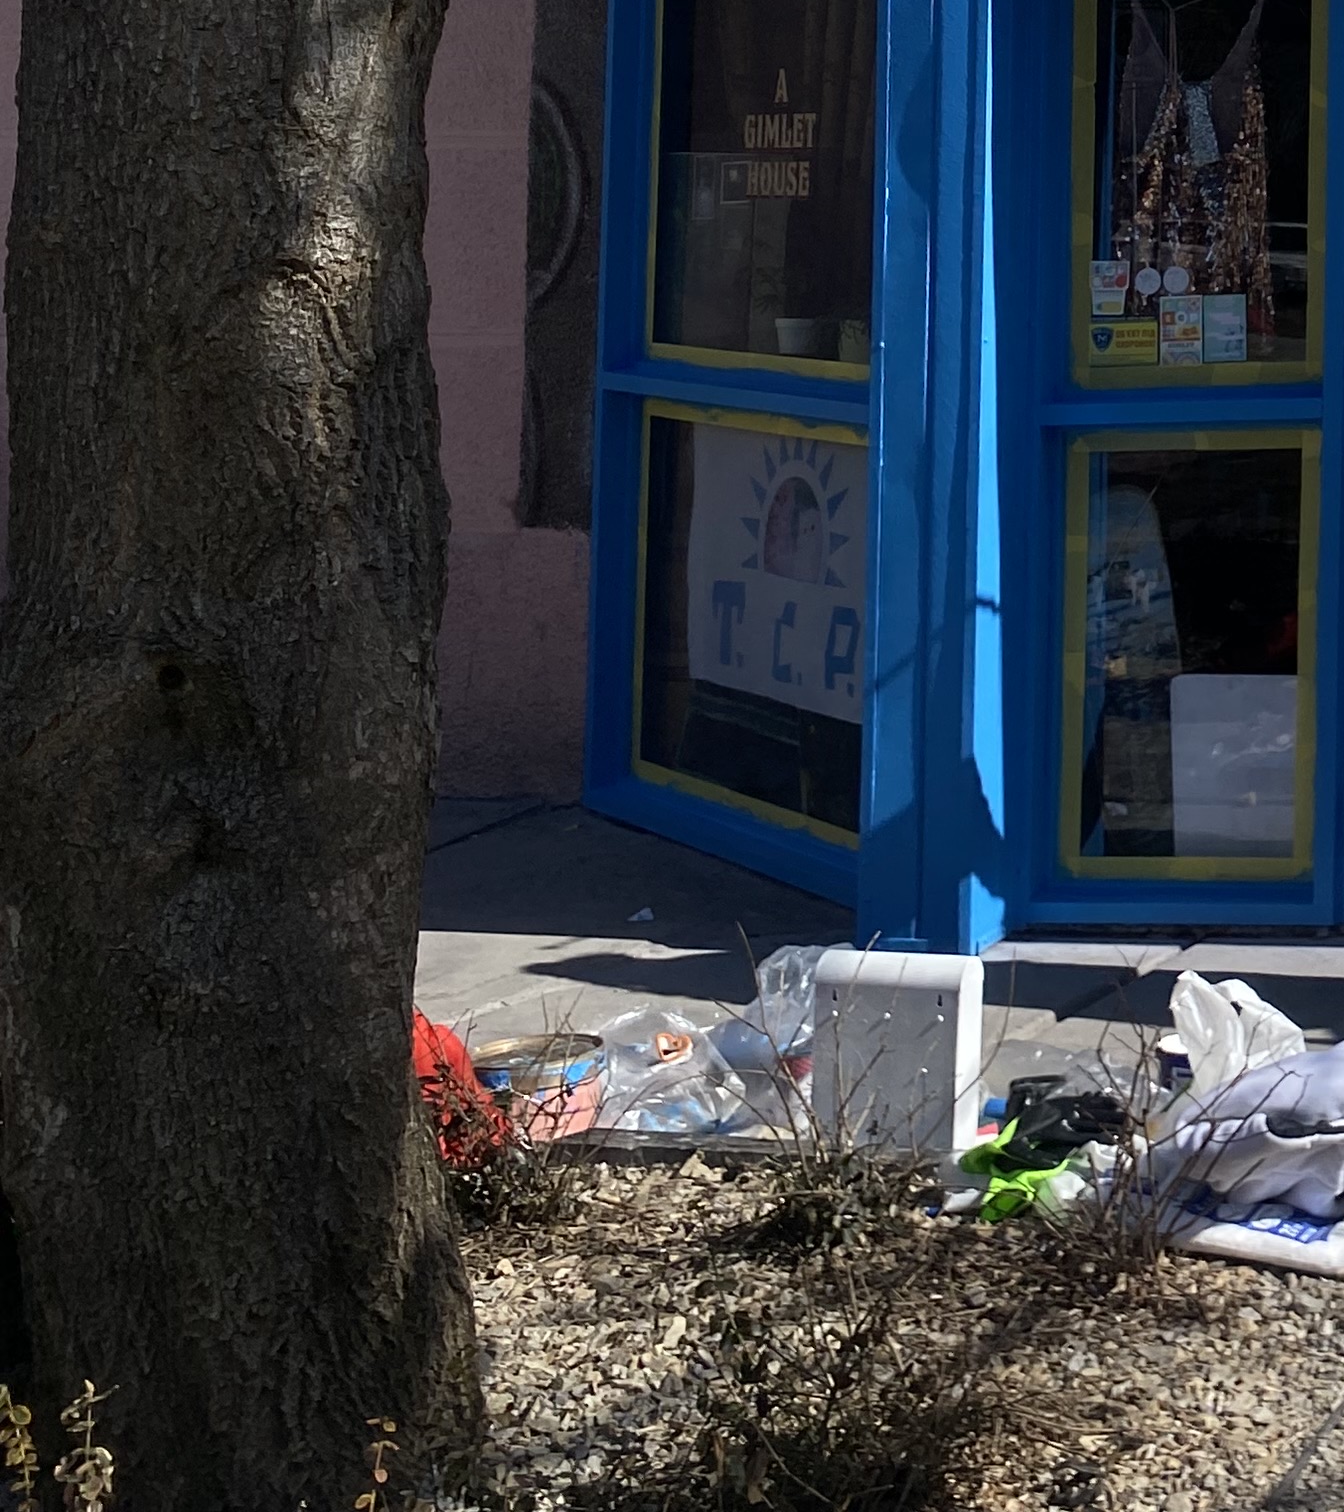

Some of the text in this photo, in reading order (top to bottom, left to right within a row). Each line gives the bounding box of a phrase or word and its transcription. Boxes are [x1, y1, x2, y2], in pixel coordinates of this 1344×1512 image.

[774, 67, 790, 104] A
[743, 112, 817, 150] GIMLET
[745, 160, 811, 198] HOUSE
